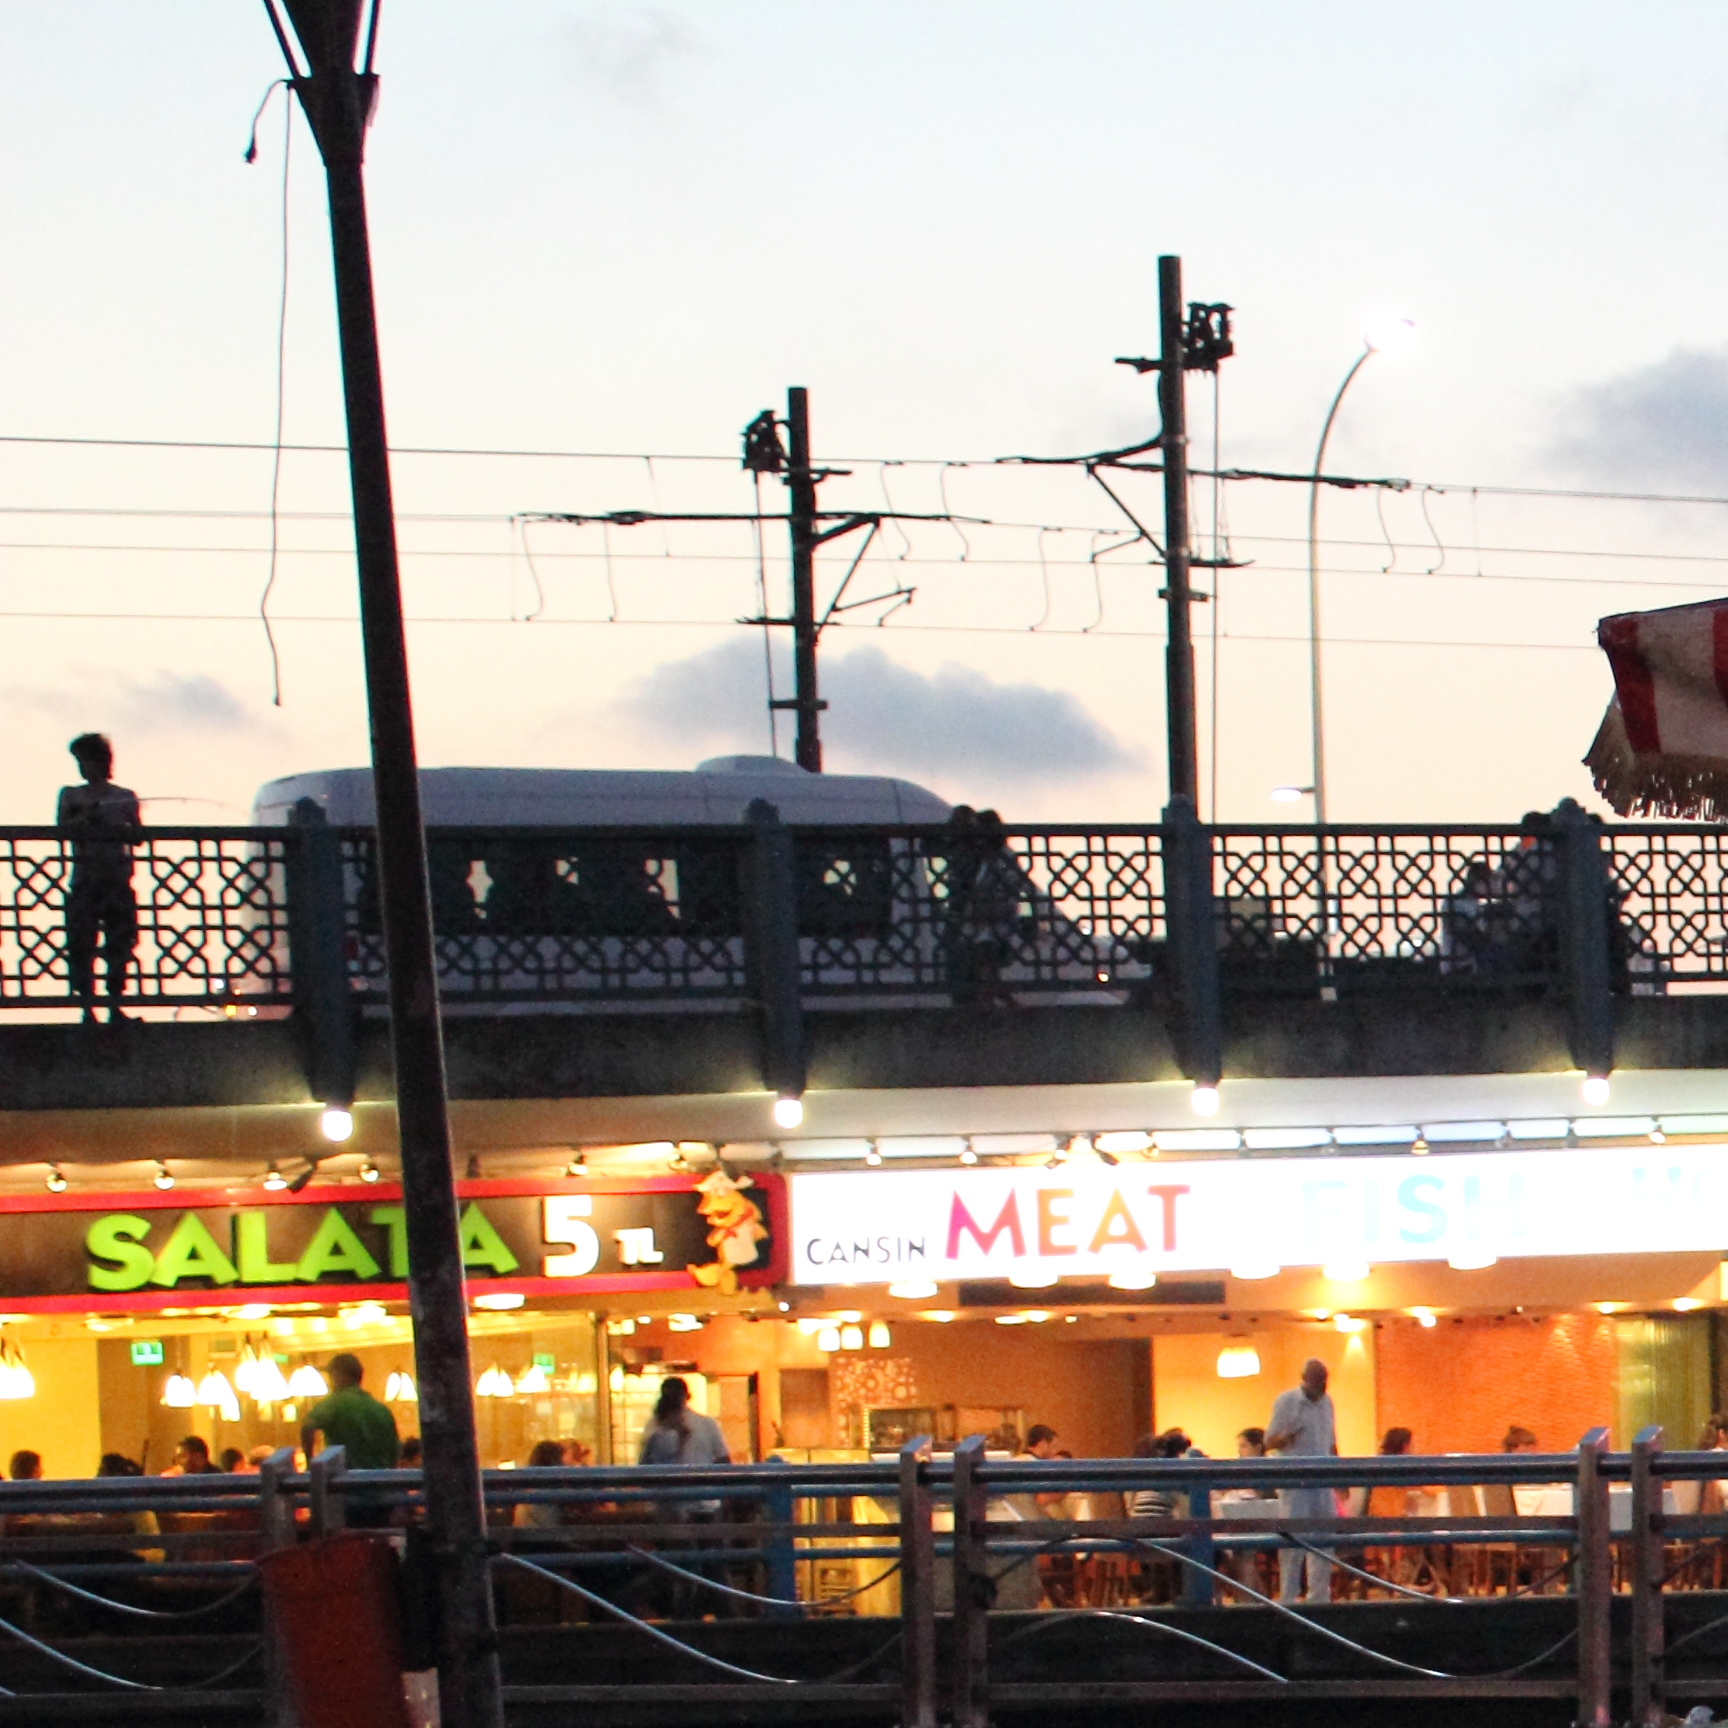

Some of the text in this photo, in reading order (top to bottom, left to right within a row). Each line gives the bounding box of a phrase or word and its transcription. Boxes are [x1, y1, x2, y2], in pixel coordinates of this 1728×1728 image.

[87, 1194, 664, 1292] SALATA 5 TL
[806, 1172, 1526, 1266] CANSIN MEAT FISH
